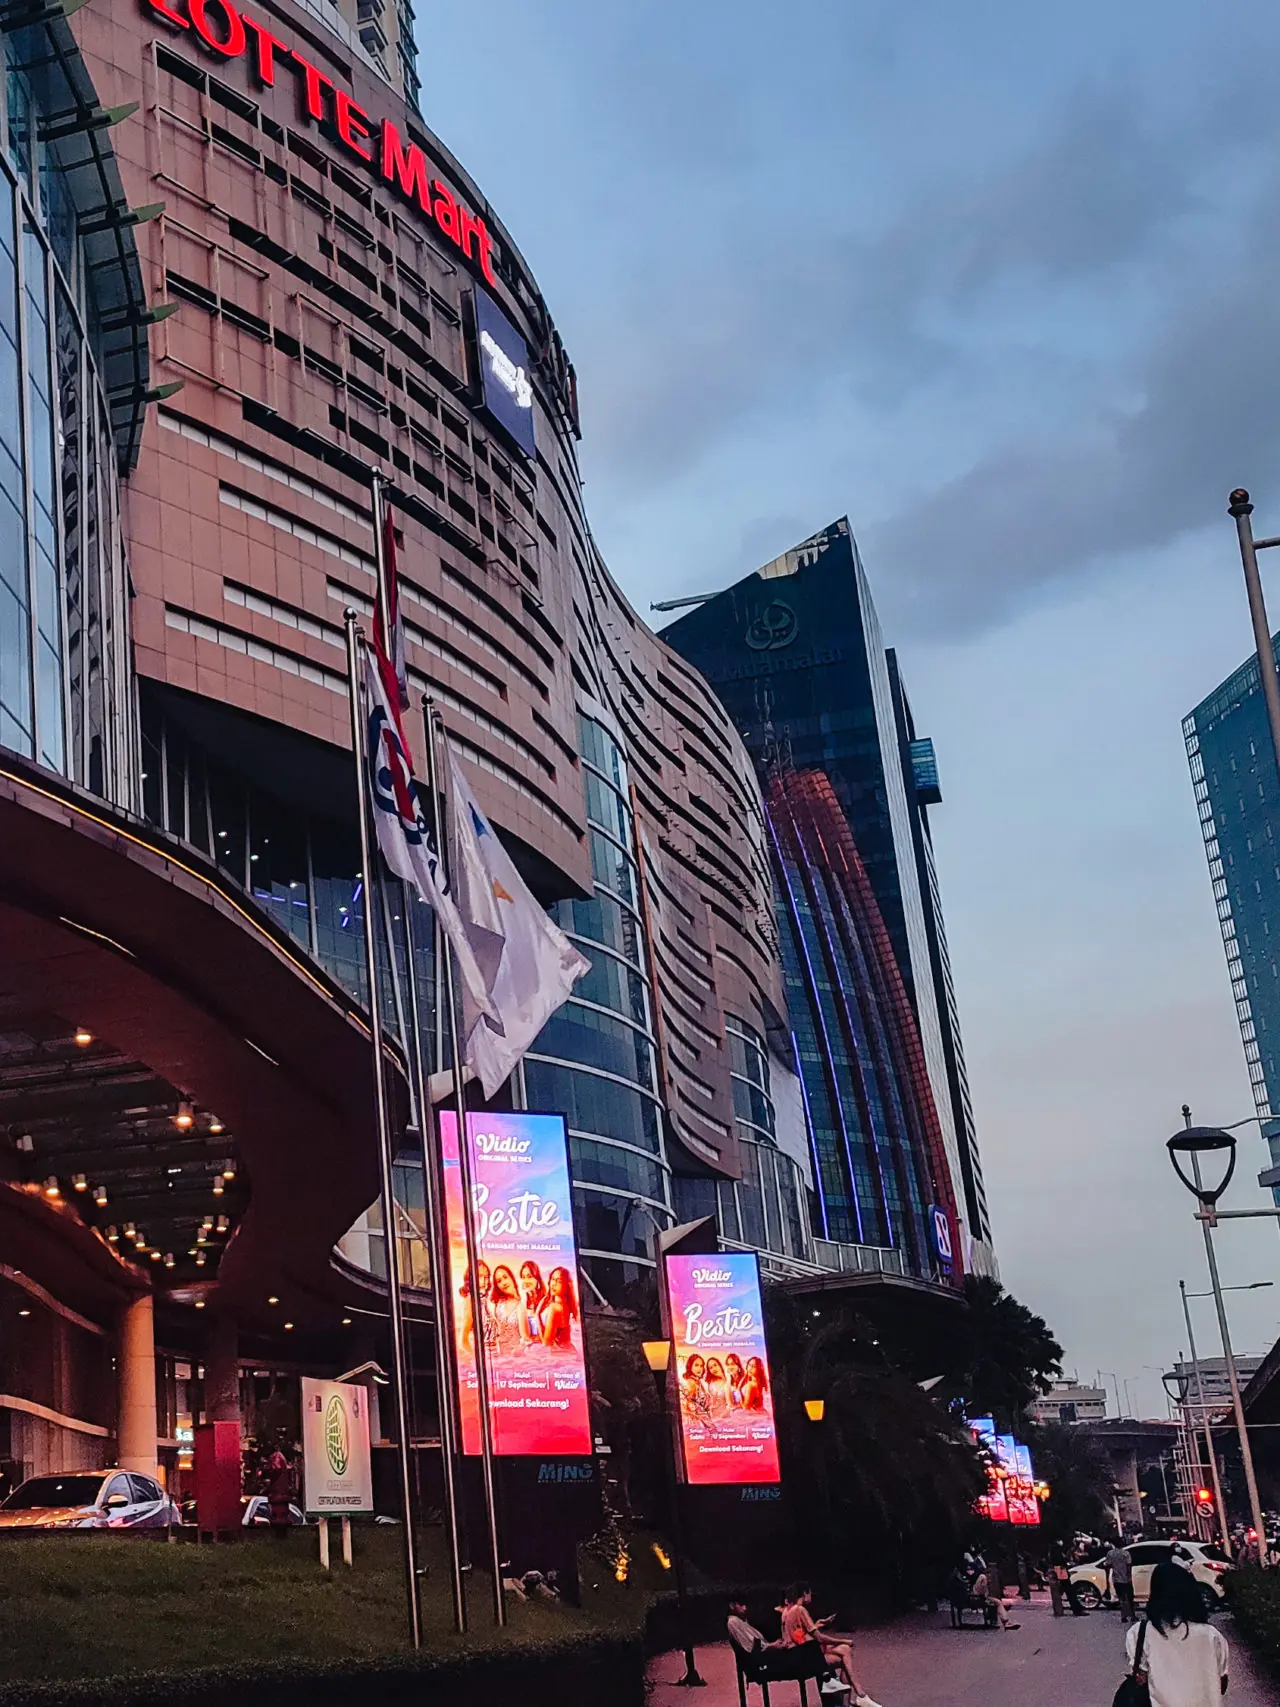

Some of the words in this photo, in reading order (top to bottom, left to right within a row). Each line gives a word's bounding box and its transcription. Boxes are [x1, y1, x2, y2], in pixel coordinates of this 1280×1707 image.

[381, 118, 496, 288] Mart
[476, 1133, 531, 1153] Vidio
[692, 1268, 732, 1283] Vidio
[683, 1303, 754, 1344] Bestie
